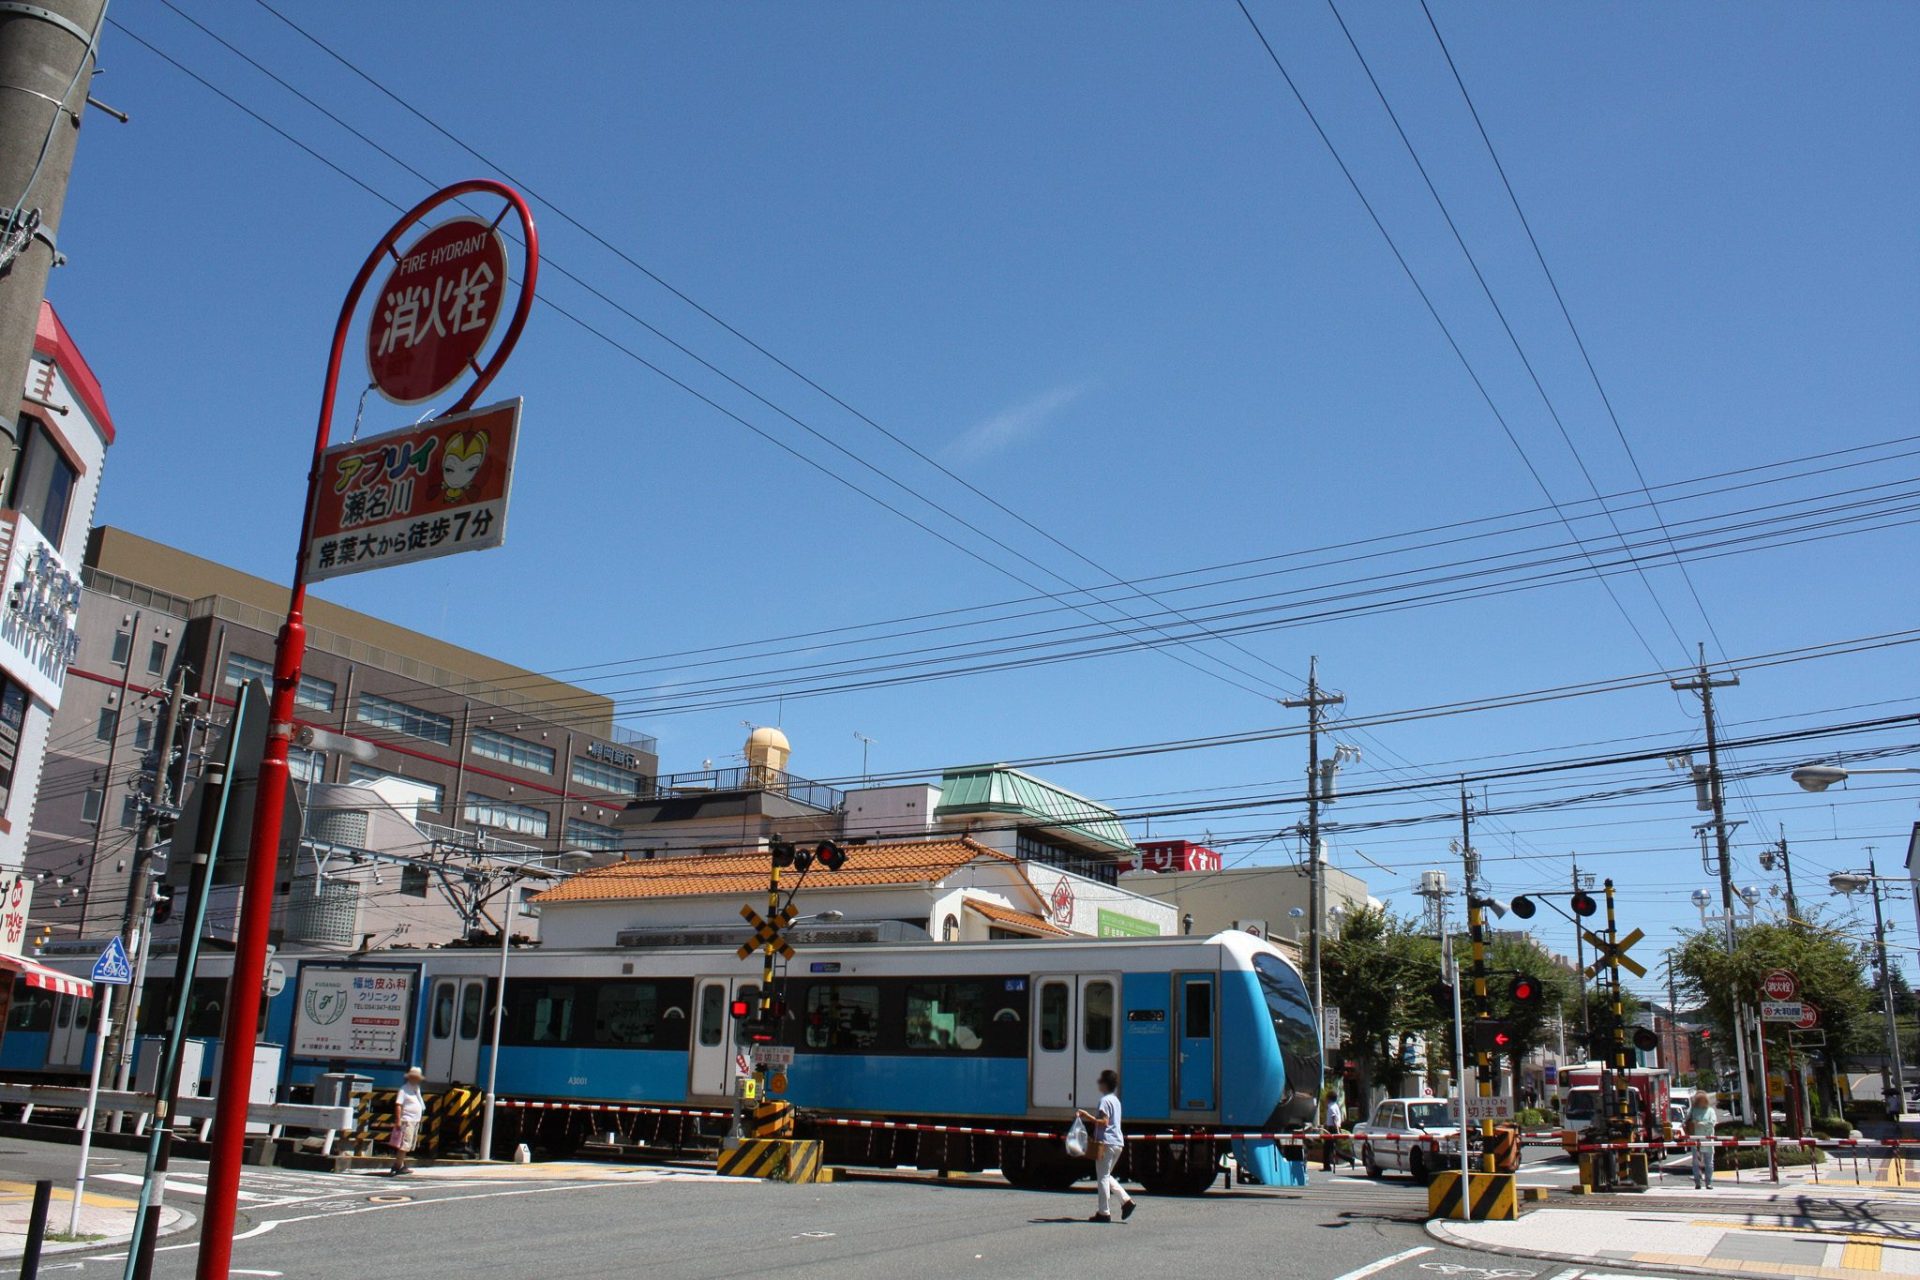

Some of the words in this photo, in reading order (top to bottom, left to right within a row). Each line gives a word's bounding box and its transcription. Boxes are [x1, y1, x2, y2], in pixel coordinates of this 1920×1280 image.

[401, 252, 428, 276] FIRE
[430, 233, 488, 267] HYDRANT
[377, 261, 495, 357] 消火栓
[335, 436, 440, 496] アプリイ
[341, 478, 415, 528] 瀬名川
[319, 508, 494, 569] 常葉大から徒歩7分
[1188, 848, 1219, 872] くすり
[5, 913, 24, 929] TAKE
[7, 929, 22, 943] OUT
[359, 992, 398, 1002] クリニック
